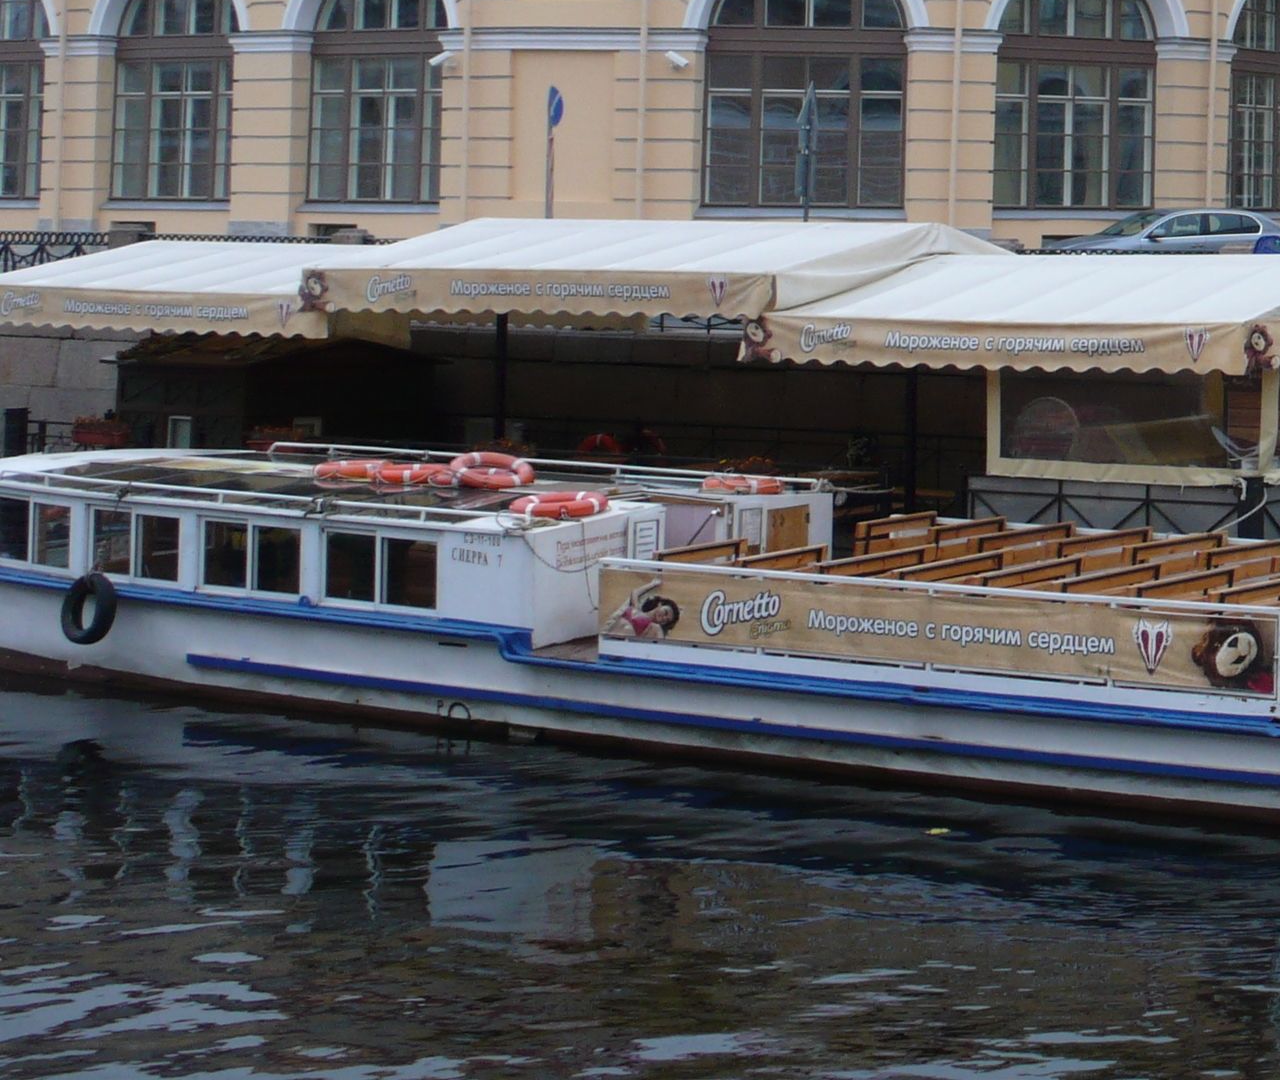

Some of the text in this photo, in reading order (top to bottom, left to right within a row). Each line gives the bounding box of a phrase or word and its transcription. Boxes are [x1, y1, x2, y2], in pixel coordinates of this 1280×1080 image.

[367, 274, 412, 303] Cornetto
[451, 279, 670, 301] Мороженое с горячим сердцем
[1, 291, 40, 316] Cornetto
[64, 299, 248, 322] Мороженое с горячим сердцем
[800, 323, 852, 352] Cornetto
[885, 331, 1145, 357] Мороженое с горячим сердцем
[701, 590, 782, 636] Cornetto
[808, 609, 1116, 656] Мороженое с горячим сердцем
